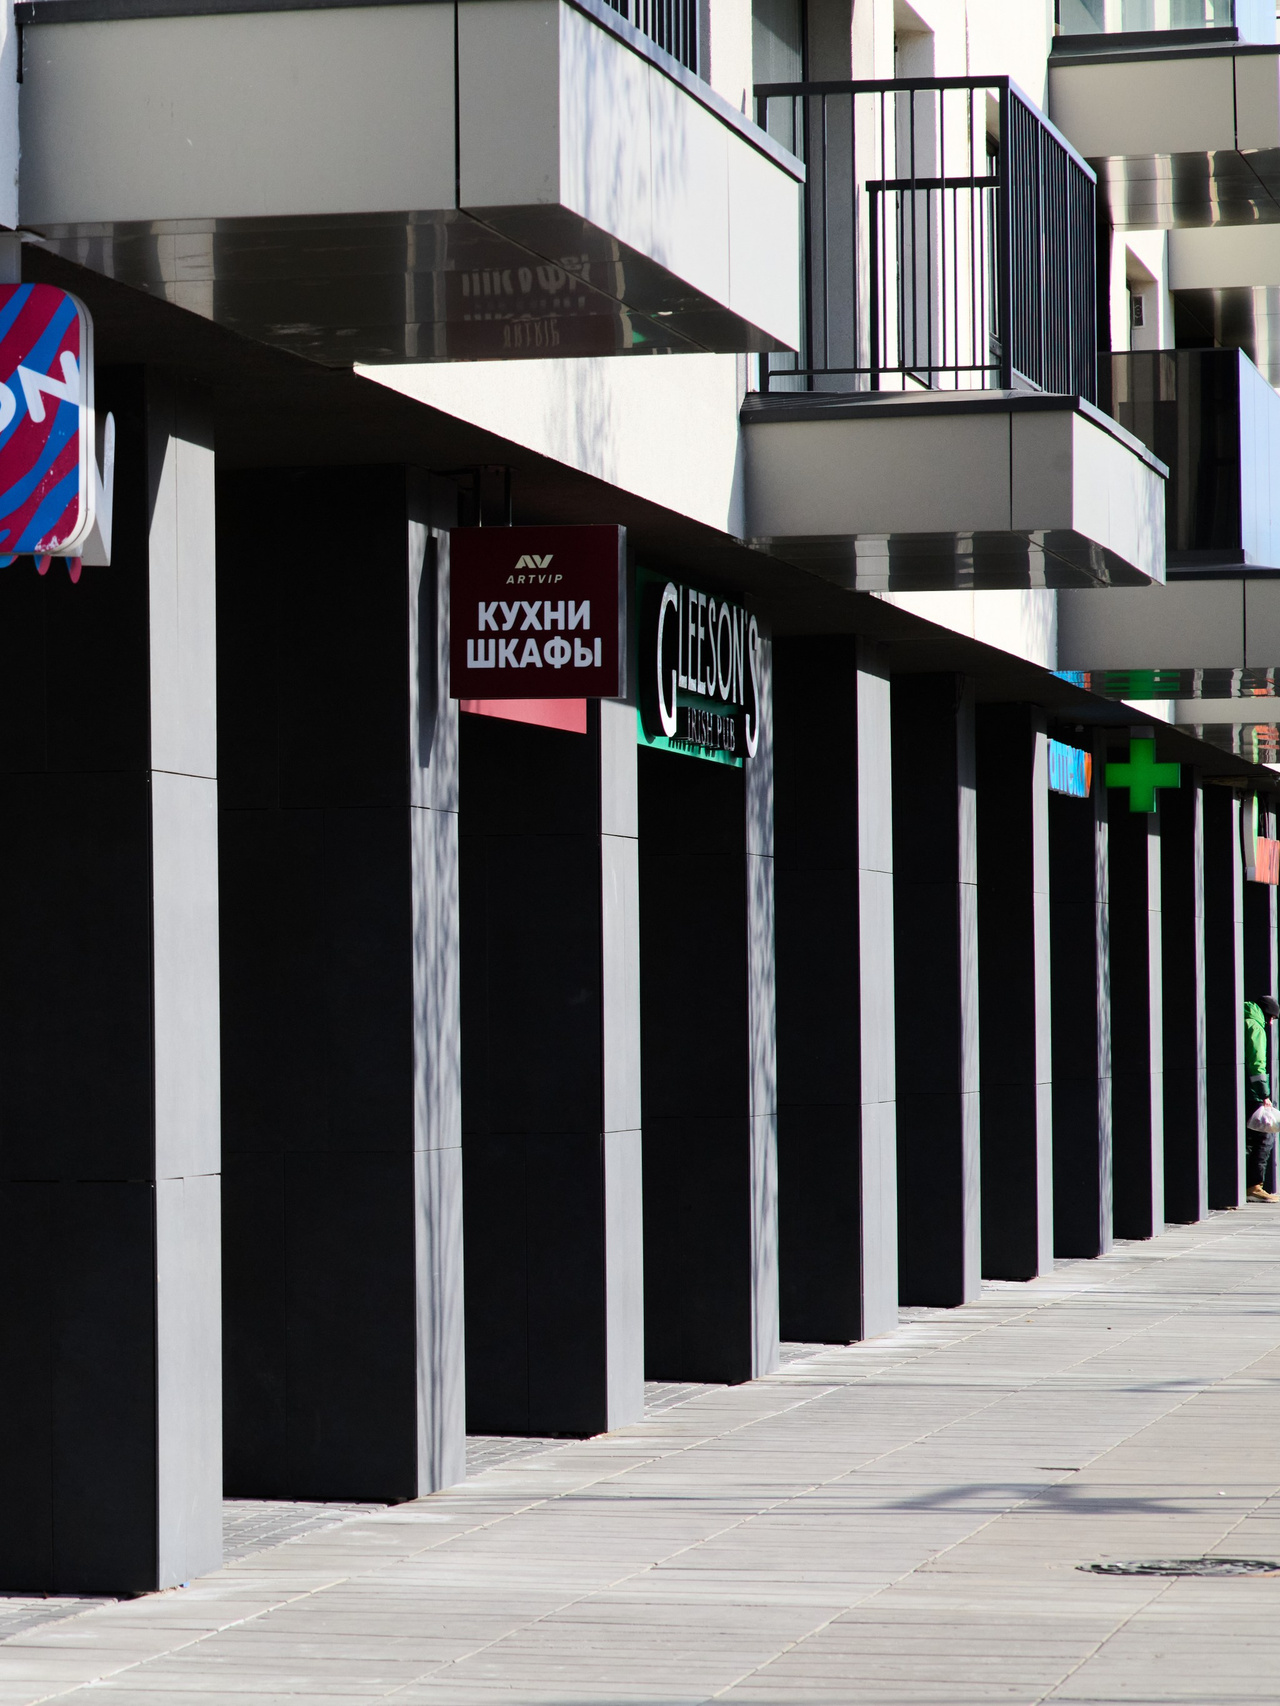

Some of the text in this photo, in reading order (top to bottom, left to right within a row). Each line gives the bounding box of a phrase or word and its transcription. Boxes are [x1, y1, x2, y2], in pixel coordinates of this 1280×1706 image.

[506, 574, 563, 585] ARTVIP
[478, 600, 591, 631] КУХНИ
[467, 636, 602, 669] ШКАФЫ
[687, 706, 736, 752] IRISH PUB
